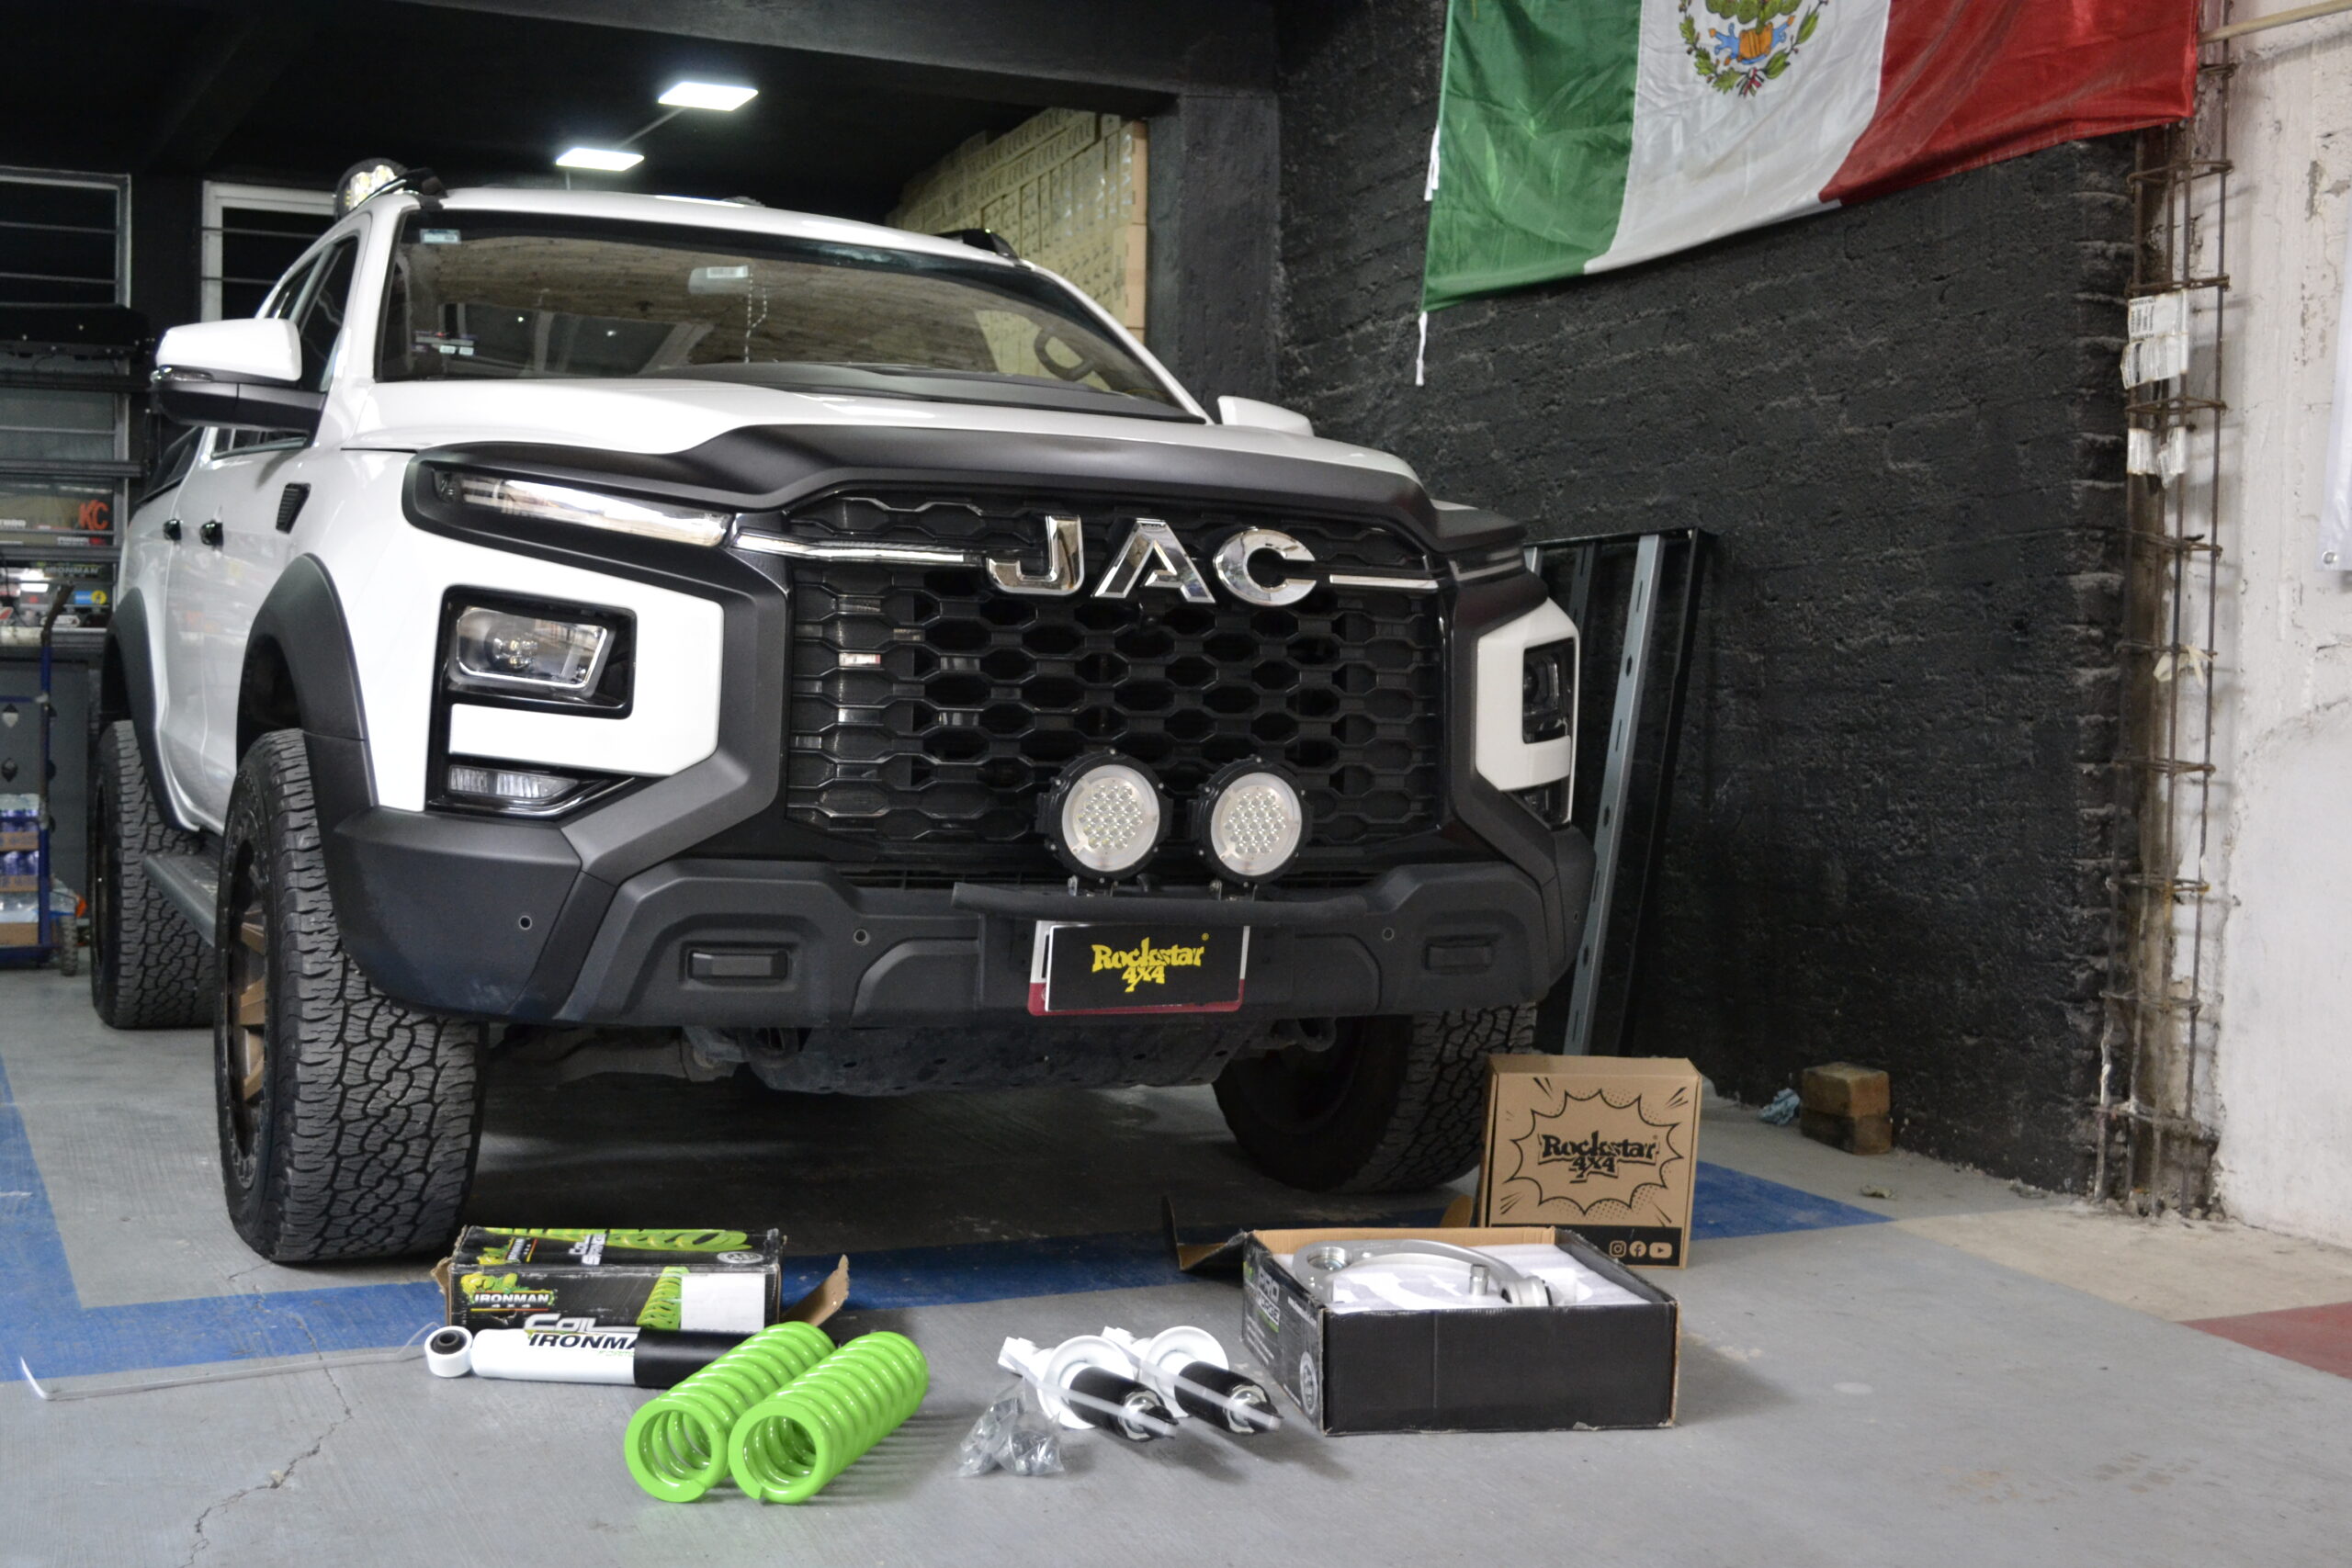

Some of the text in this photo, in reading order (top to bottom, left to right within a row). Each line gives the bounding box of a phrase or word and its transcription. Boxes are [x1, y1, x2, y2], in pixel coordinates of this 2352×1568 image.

[79, 500, 109, 530] KC
[987, 515, 1317, 606] JAC
[1091, 936, 1205, 973] Rockstar
[1541, 1130, 1657, 1159] Rockstar
[474, 1293, 549, 1303] IRONMAN
